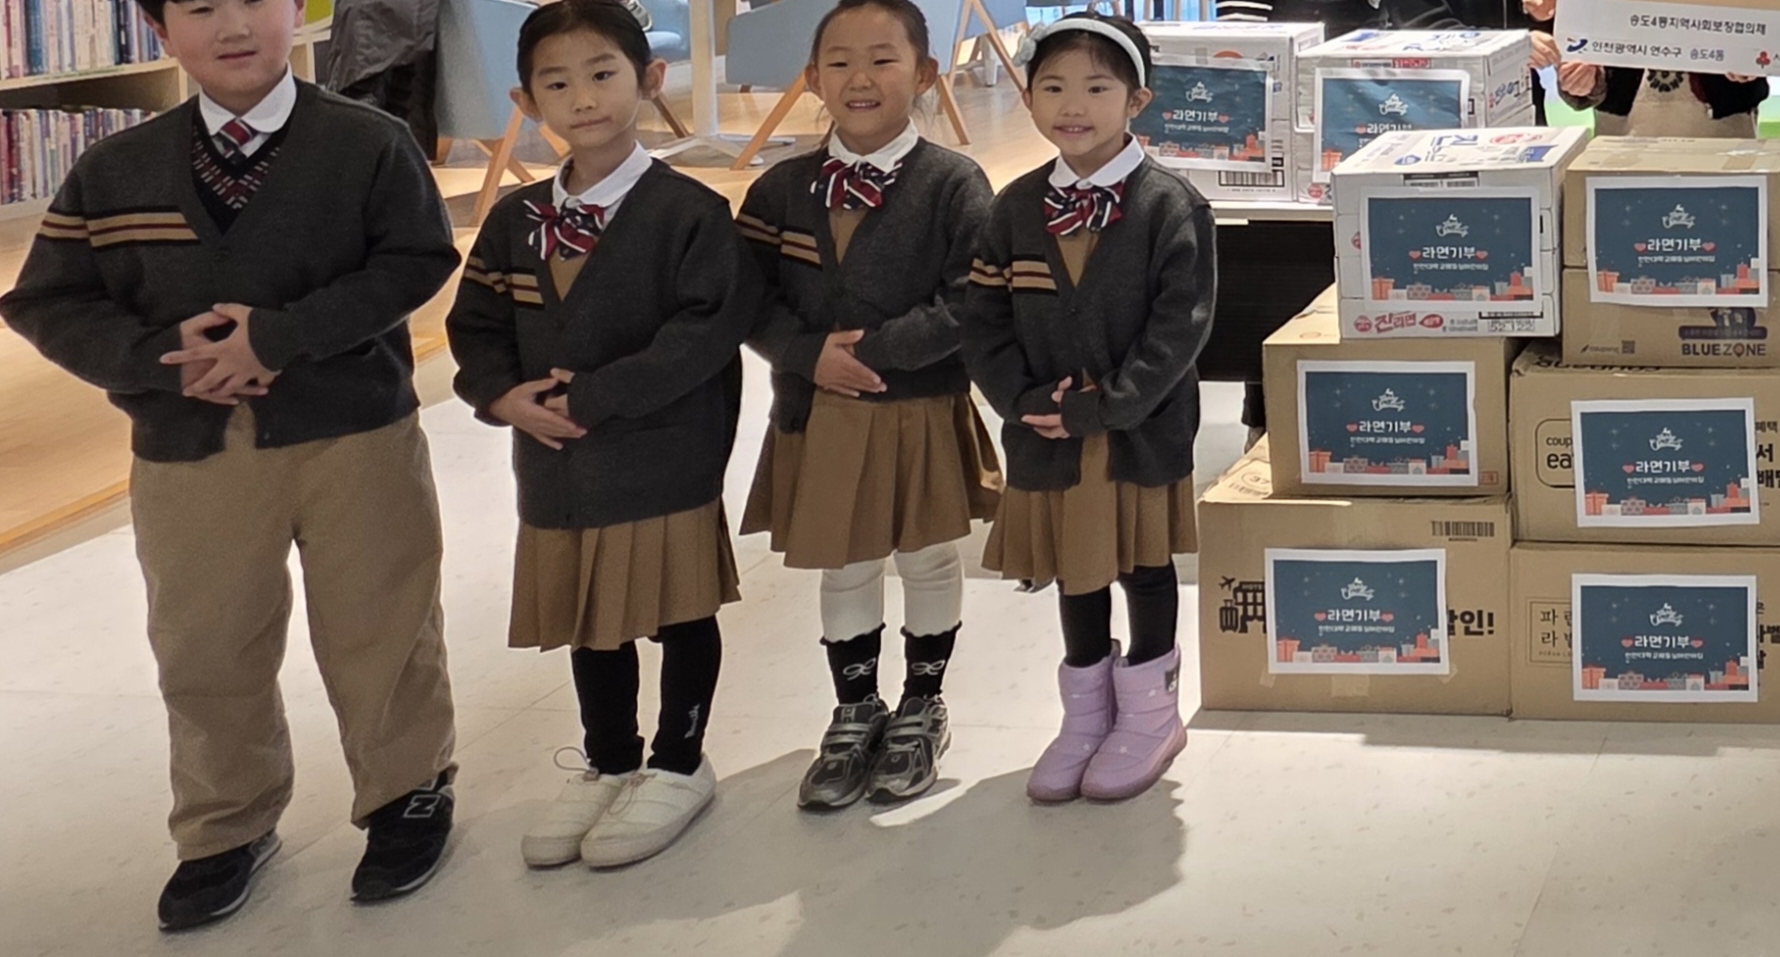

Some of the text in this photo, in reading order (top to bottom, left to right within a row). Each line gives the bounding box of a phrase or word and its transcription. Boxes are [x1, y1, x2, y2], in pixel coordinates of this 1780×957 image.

[1592, 41, 1725, 61] 인천광역시 연수구 송도4동
[1172, 109, 1218, 123] 라면기부
[1647, 238, 1702, 252] 라면기부
[1422, 246, 1476, 260] 라면기부
[1358, 421, 1412, 433] 라면기부
[1547, 453, 1572, 470] ea
[1635, 460, 1690, 473] 라면기부
[1327, 609, 1381, 622] 라면기부
[1634, 635, 1690, 649] 라면기부
